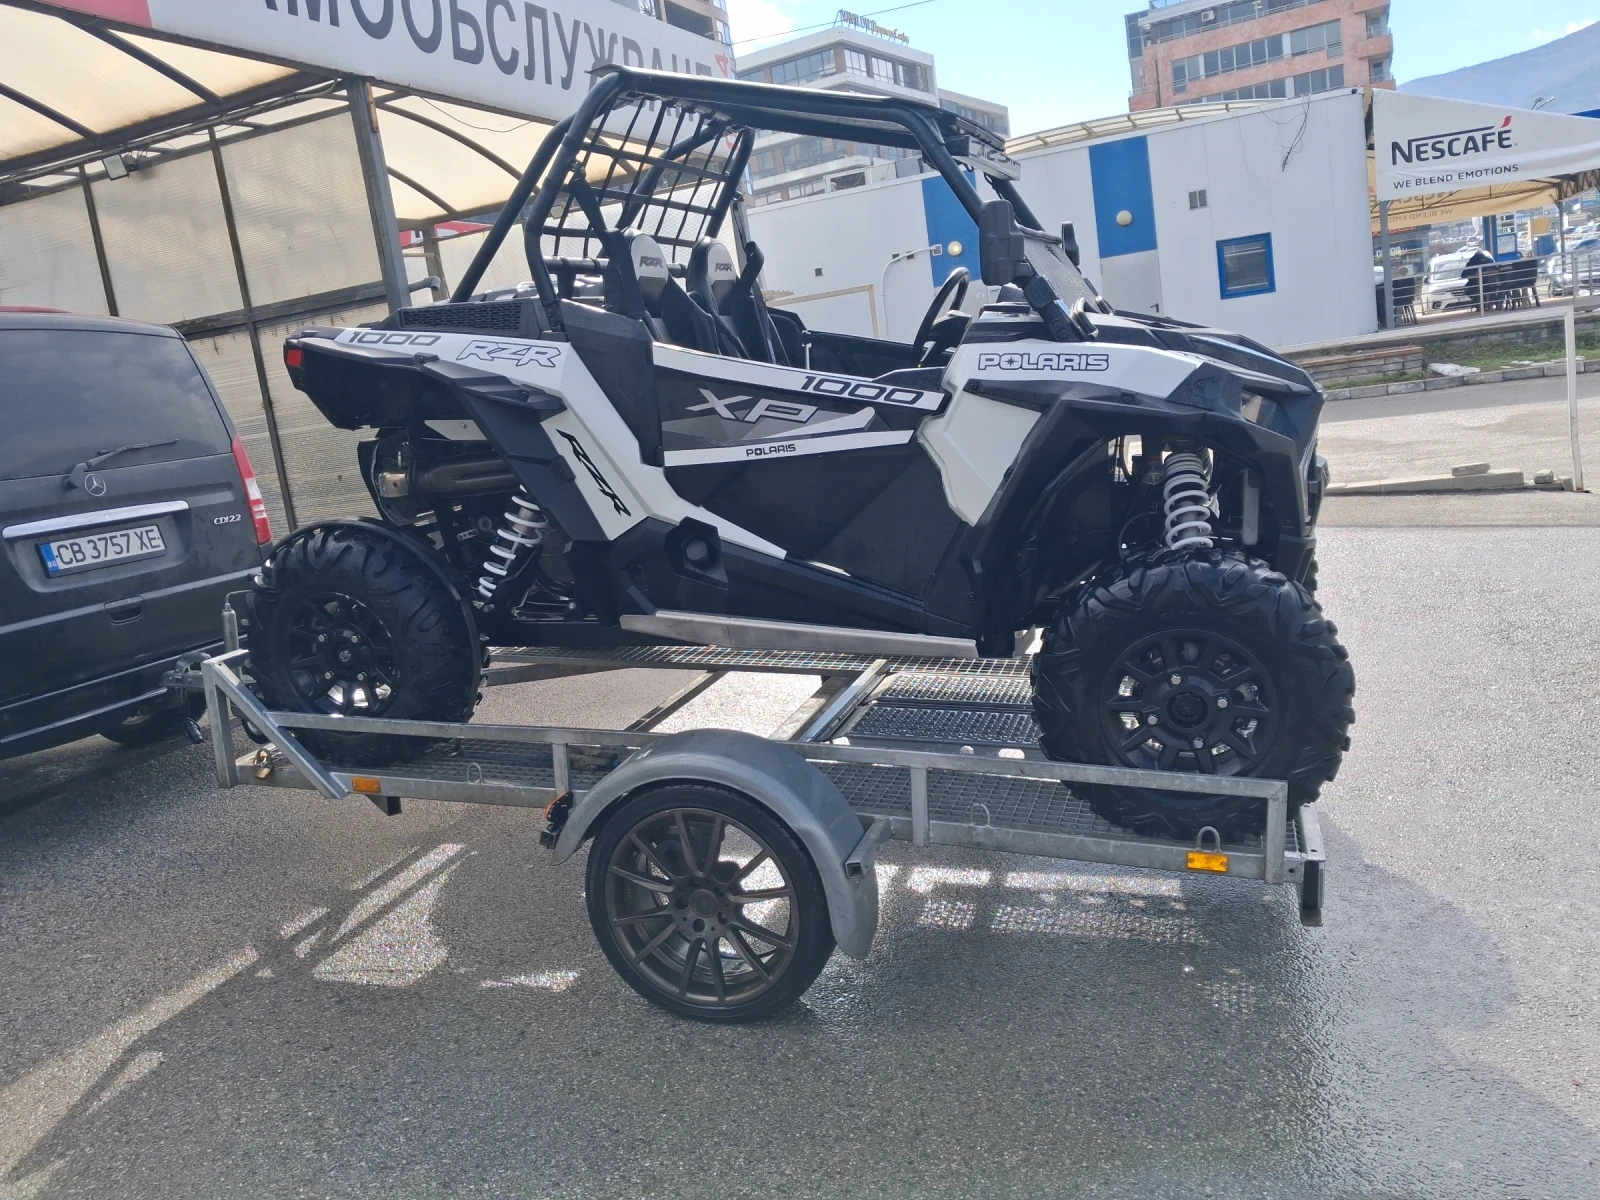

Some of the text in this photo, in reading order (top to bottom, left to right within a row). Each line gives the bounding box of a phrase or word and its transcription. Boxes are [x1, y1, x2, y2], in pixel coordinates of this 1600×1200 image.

[1391, 115, 1512, 165] NESCAFÉ
[1393, 164, 1519, 189] WE BLEND EMOTIONS
[639, 256, 664, 269] RZR
[715, 263, 733, 273] RZR
[348, 331, 562, 368] 1000 RZR
[978, 353, 1110, 371] POLARIS
[800, 375, 925, 405] 1000
[684, 388, 819, 424] XP
[746, 443, 797, 457] POLARIS
[213, 516, 229, 525] CDI
[58, 529, 161, 565] CB 3757 XE
[47, 560, 58, 568] BG
